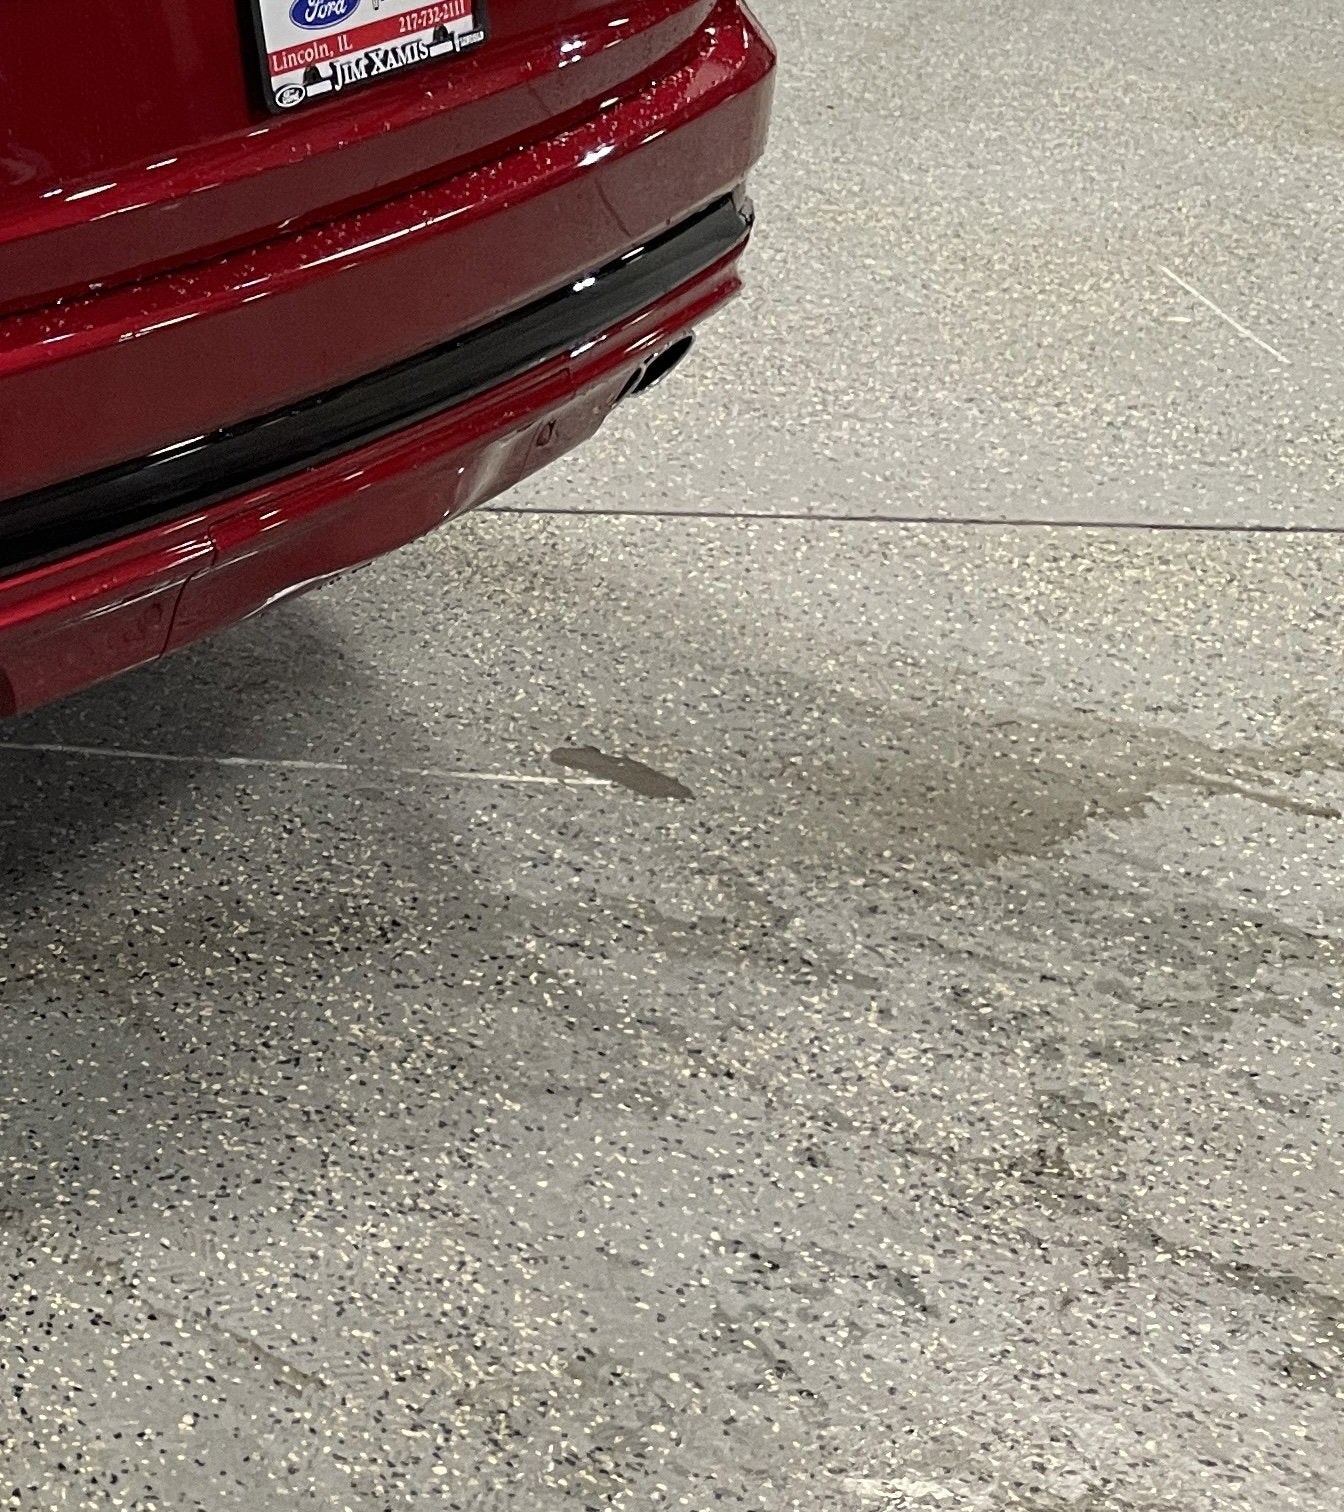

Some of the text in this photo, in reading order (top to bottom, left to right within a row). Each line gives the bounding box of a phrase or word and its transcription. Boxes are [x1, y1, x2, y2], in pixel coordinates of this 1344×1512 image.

[399, 0, 465, 33] 217-732-2111
[273, 35, 353, 72] Lincoln, IL
[335, 61, 370, 90] JIM
[370, 41, 429, 76] XAMIS
